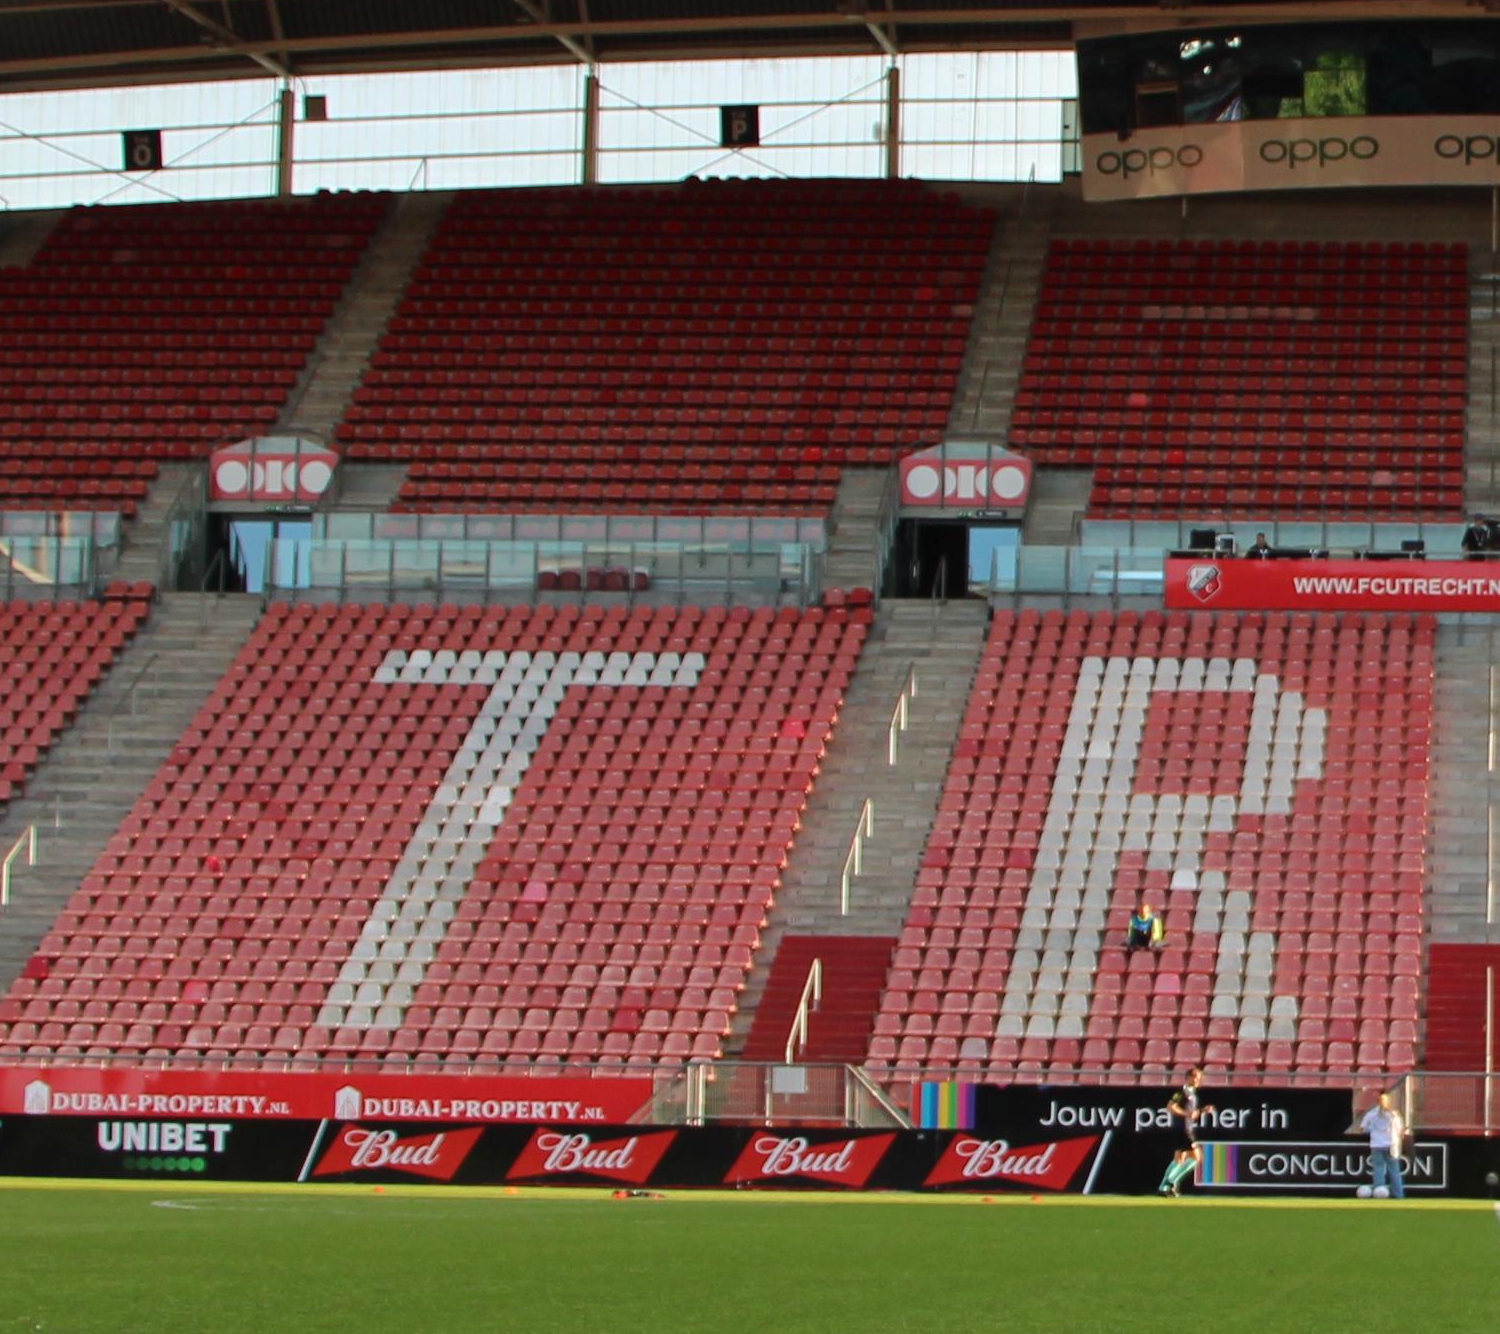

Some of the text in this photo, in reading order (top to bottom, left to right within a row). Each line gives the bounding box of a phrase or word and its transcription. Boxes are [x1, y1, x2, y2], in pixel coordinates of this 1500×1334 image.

[1097, 143, 1203, 179] oppo
[1259, 135, 1379, 169] oppo
[52, 1092, 290, 1115] DUBAI-PROPERTY.NL
[363, 1098, 605, 1120] DUBAI-PROPERTY.NL
[1040, 1101, 1288, 1131] Jouw paner in
[98, 1122, 231, 1153] UNIBET
[344, 1130, 444, 1167] Bud
[537, 1133, 638, 1172] Bud
[754, 1137, 856, 1175] Bud
[956, 1139, 1056, 1177] Bud
